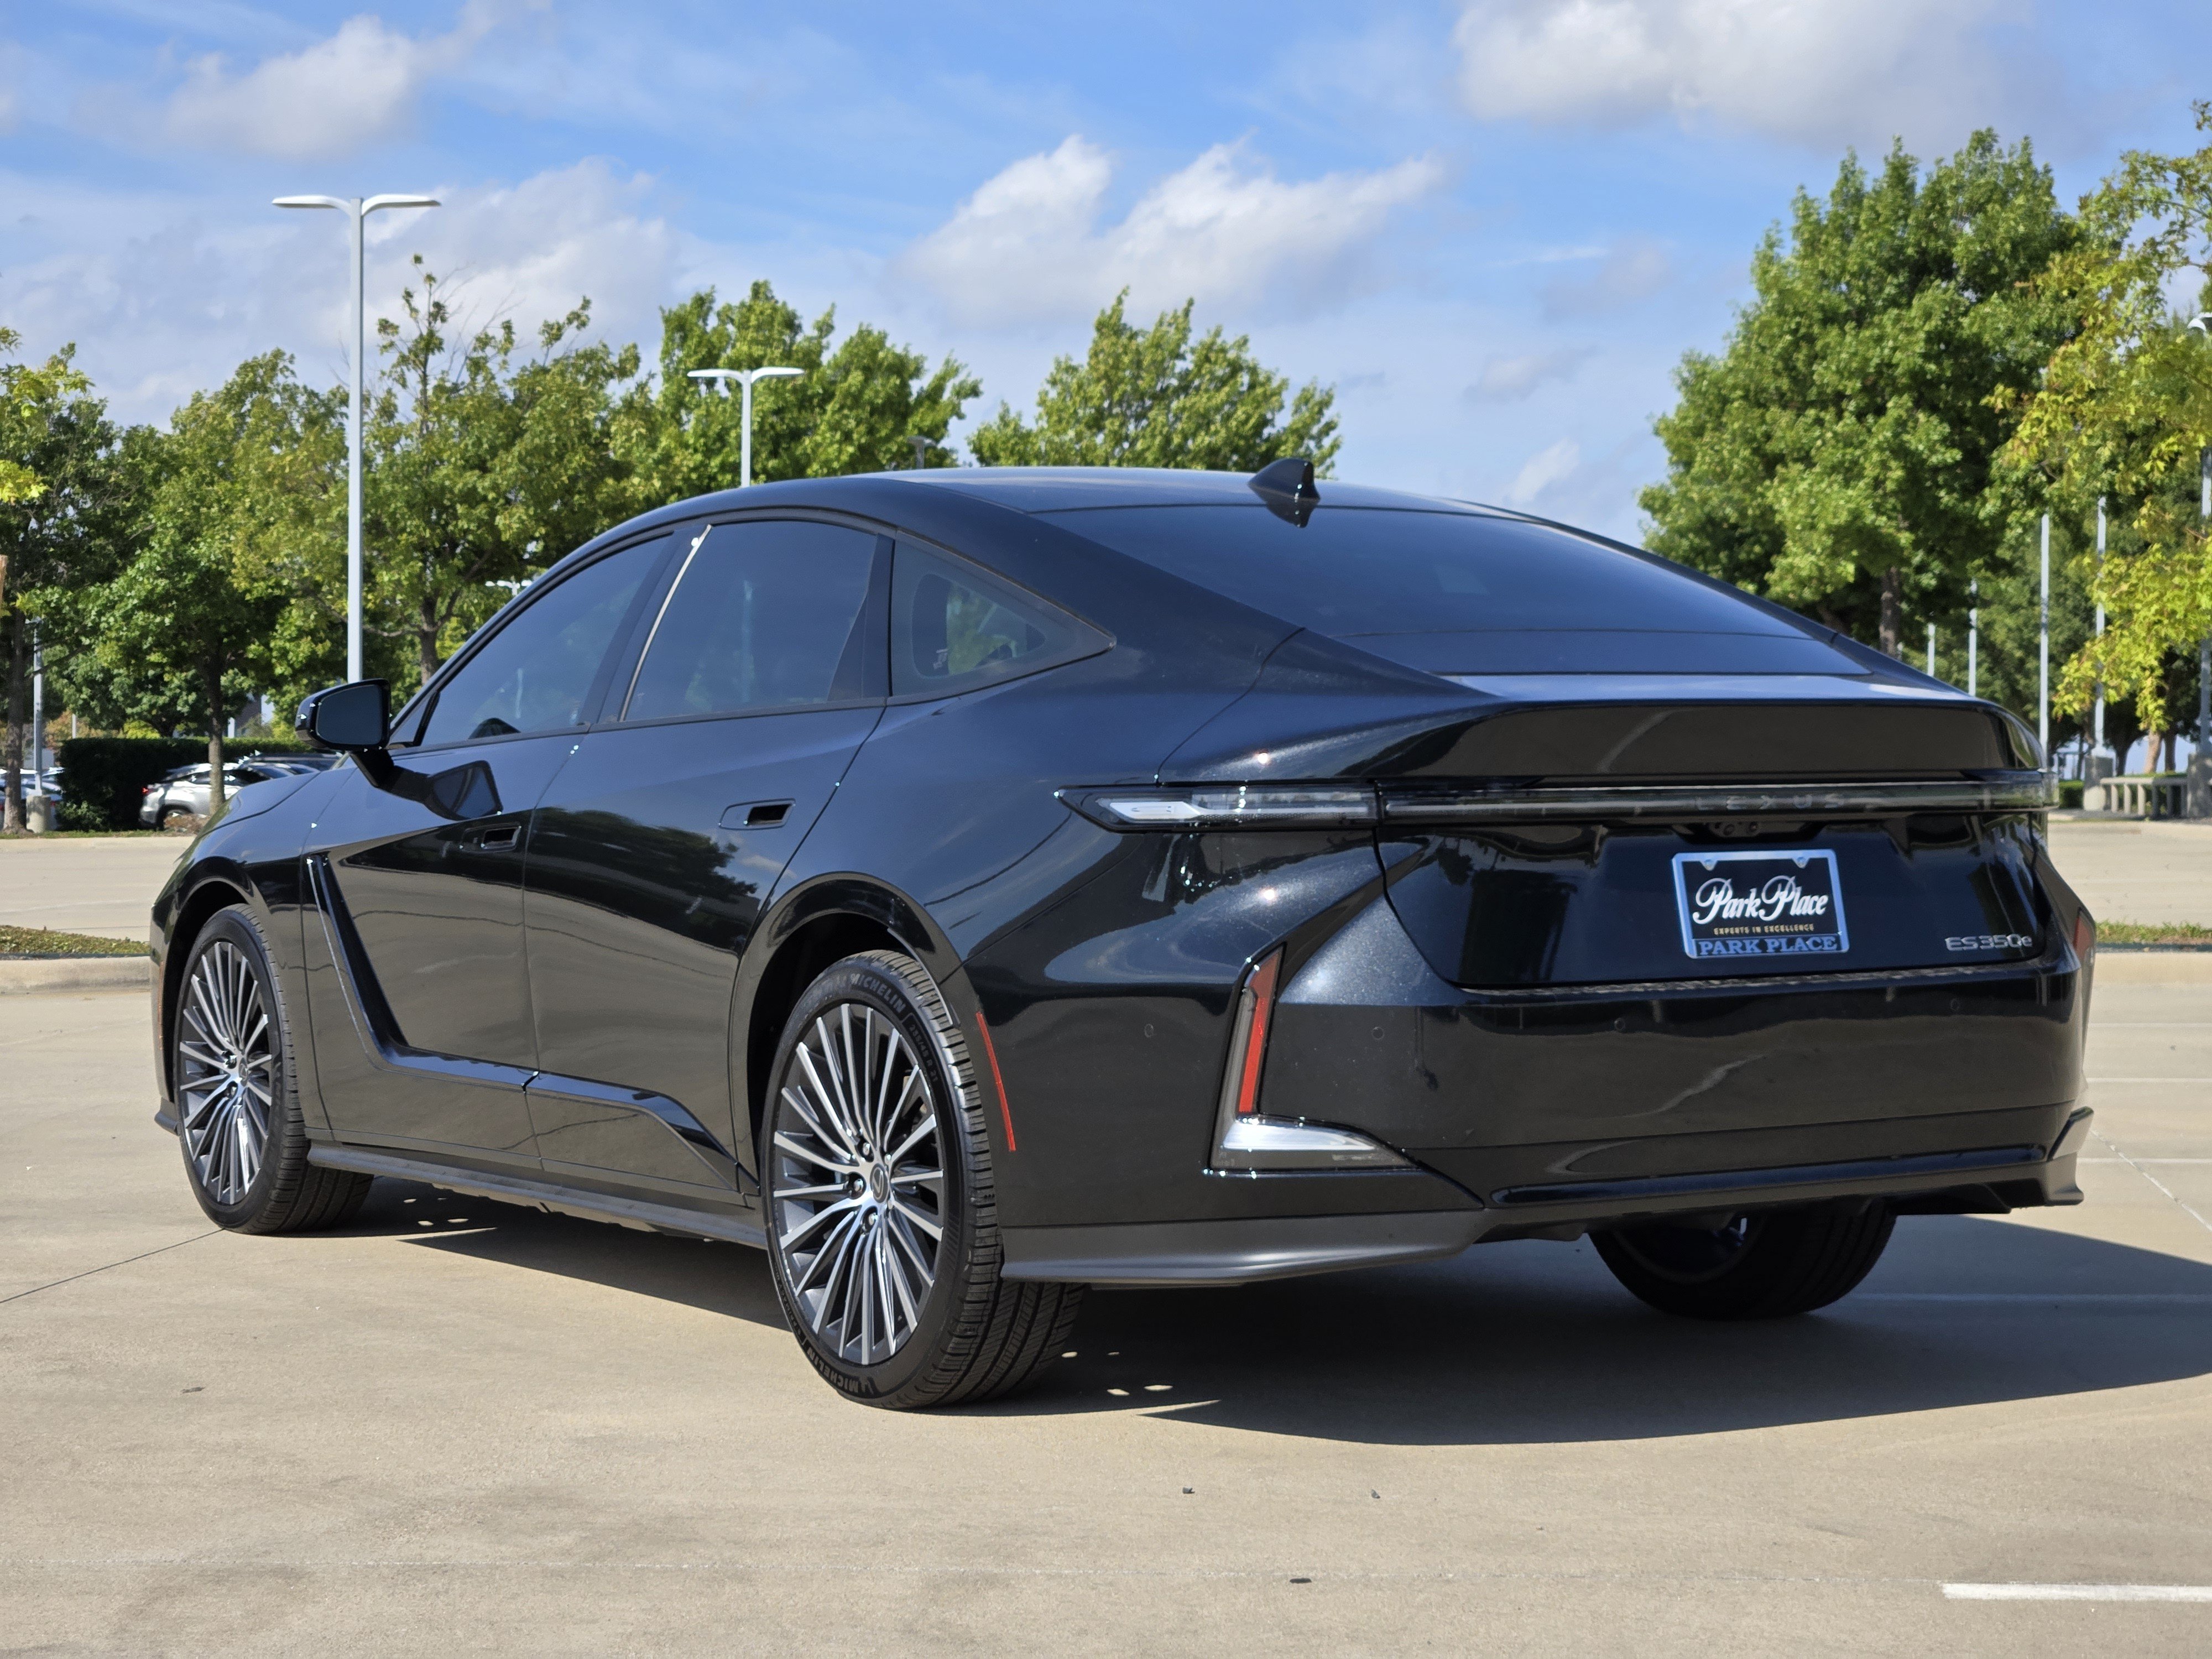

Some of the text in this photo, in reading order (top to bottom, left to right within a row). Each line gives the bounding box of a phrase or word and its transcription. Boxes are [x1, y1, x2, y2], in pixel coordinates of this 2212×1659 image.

[1695, 794, 1844, 810] LEXUS
[1692, 875, 1829, 924] Park Place
[1713, 926, 1749, 936] EXPERTS
[1764, 924, 1815, 933] EXCELLENCE
[1699, 936, 1838, 956] PARK PLACE
[850, 973, 907, 1014] MICHELIN
[807, 1347, 859, 1393] MICHELIN
